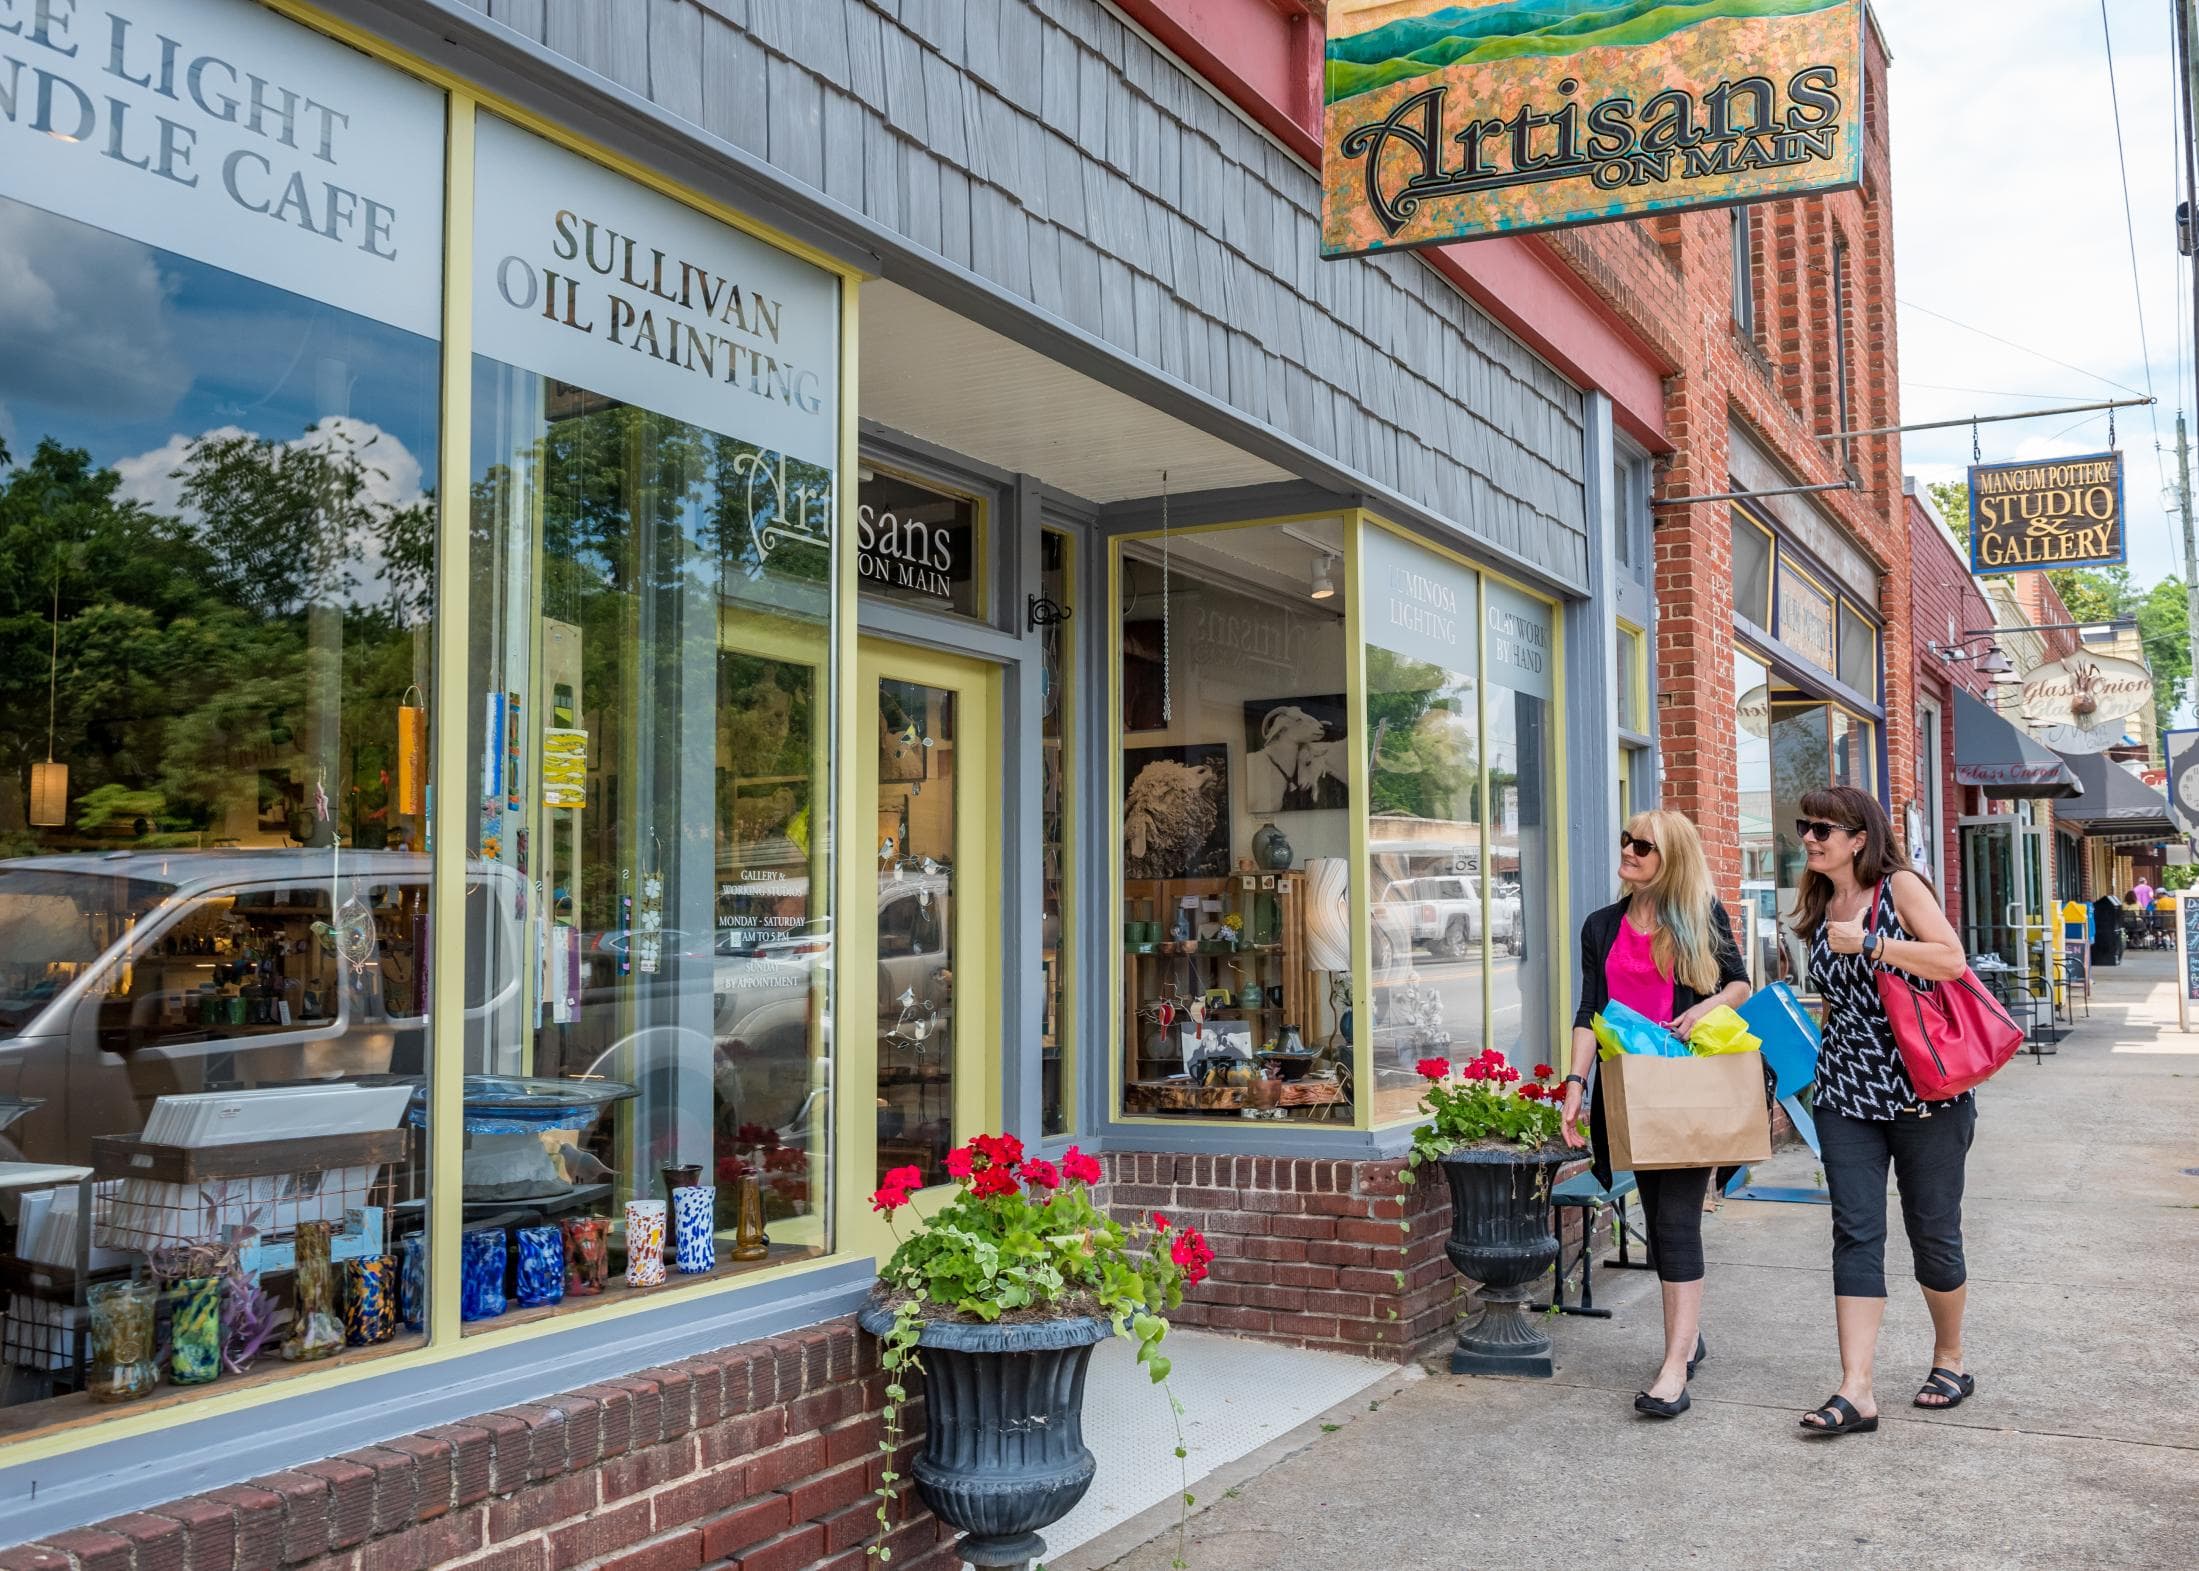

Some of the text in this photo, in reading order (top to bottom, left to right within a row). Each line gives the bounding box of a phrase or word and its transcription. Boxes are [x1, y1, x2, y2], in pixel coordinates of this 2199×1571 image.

[102, 11, 350, 165] LIGHT
[1341, 65, 1842, 239] Artisans
[1591, 126, 1838, 190] ON MAIN
[221, 150, 398, 261] CAFE
[553, 209, 782, 344] SULLIVAN
[496, 254, 822, 416] OIL PAINTING
[1980, 461, 2112, 494] MANGUM POTTERY
[1980, 487, 2114, 533] STUDIO
[2026, 517, 2069, 536] &
[1981, 520, 2114, 565] GALLERY
[858, 552, 951, 598] ON MAIN
[1389, 598, 1456, 645] LIGHTING
[1496, 638, 1542, 674] BY HAND
[2023, 677, 2151, 705] Glass Onion
[1959, 764, 2061, 779] Glass Onion
[741, 870, 777, 881] GALLERY
[719, 917, 758, 926] MONDAY
[763, 917, 805, 926] SATURDAY
[742, 931, 756, 942] AM
[757, 931, 769, 942] TO
[771, 931, 776, 941] 5
[777, 931, 789, 942] PM
[725, 976, 798, 988] BY APPOINTMENT
[745, 961, 778, 972] SUNDAY
